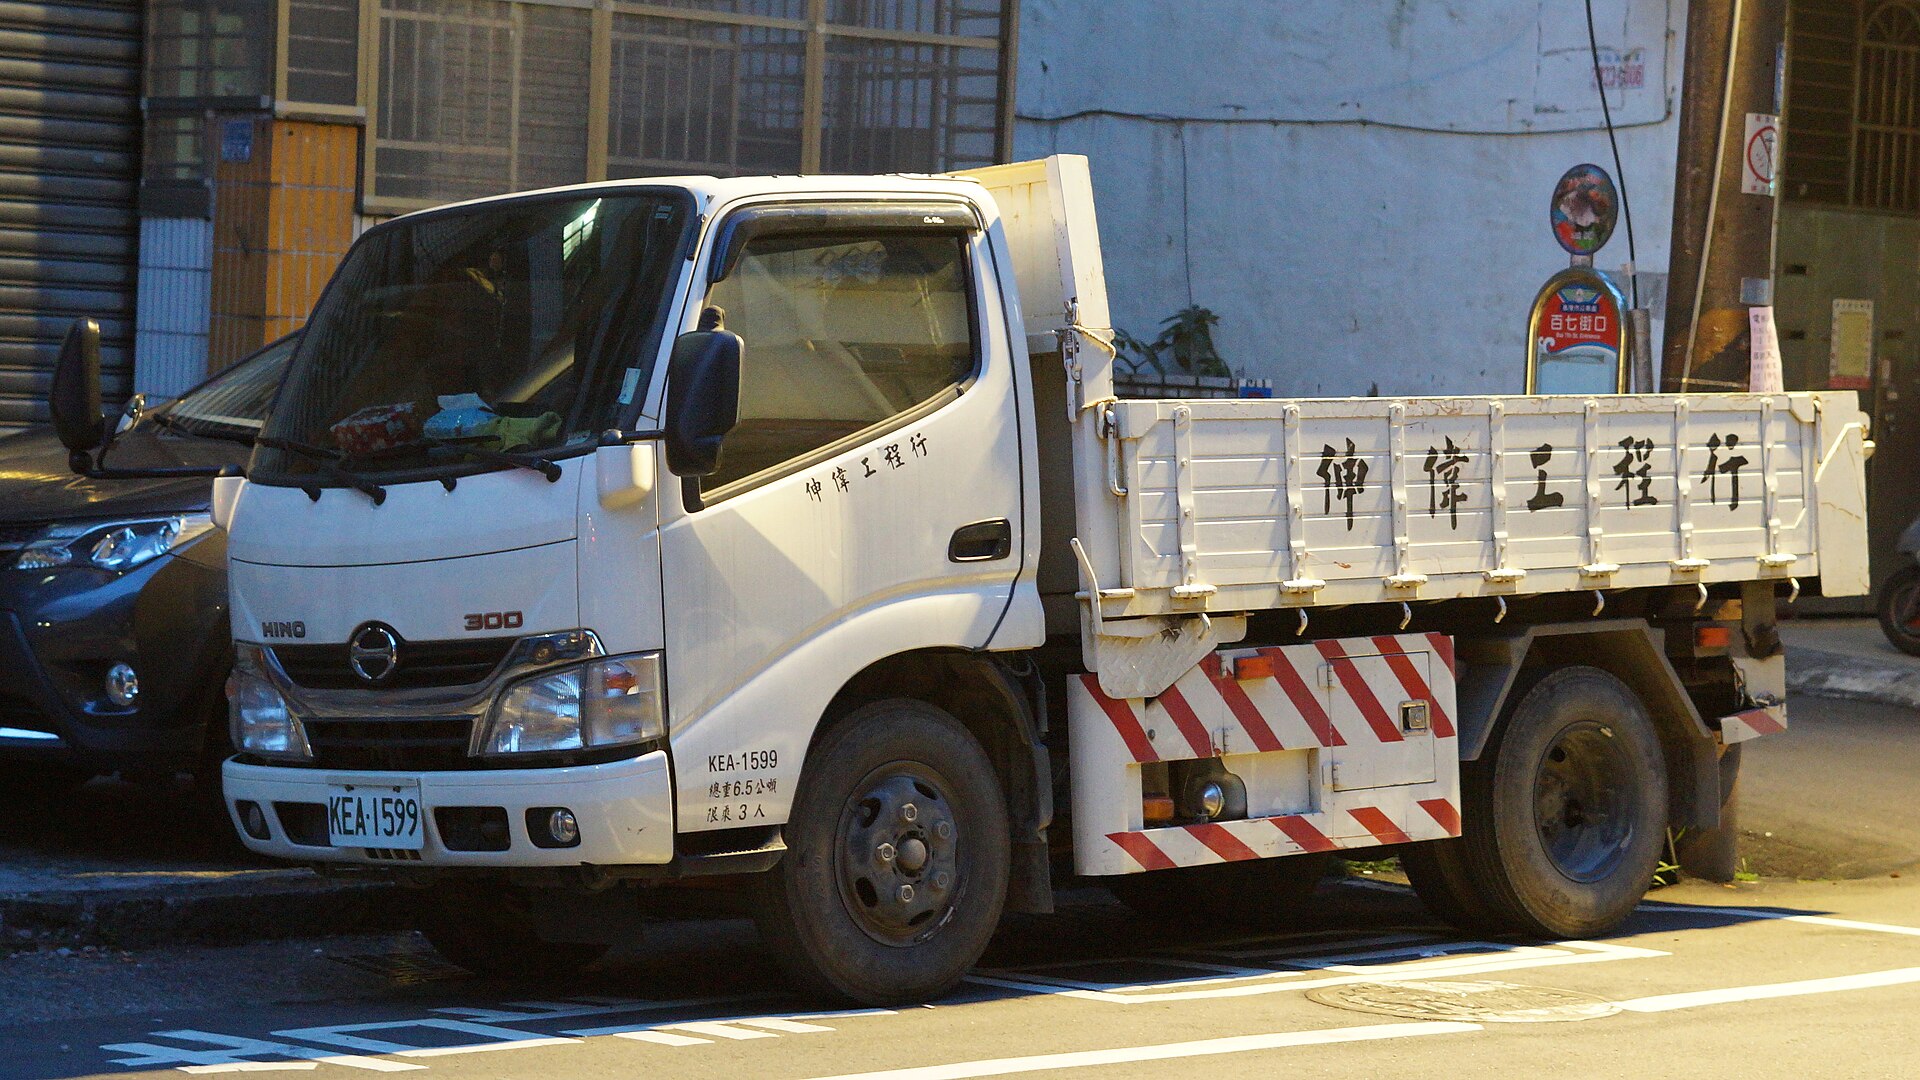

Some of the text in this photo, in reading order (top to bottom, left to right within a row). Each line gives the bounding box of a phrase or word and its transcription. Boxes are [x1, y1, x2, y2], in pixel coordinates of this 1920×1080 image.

[1551, 314, 1606, 332] 百七街口
[806, 432, 927, 502] 伸偉工程行
[1316, 432, 1749, 531] 伸偉工程行
[262, 621, 306, 638] HINO
[464, 610, 523, 631] 300
[708, 749, 778, 772] KEA-1599
